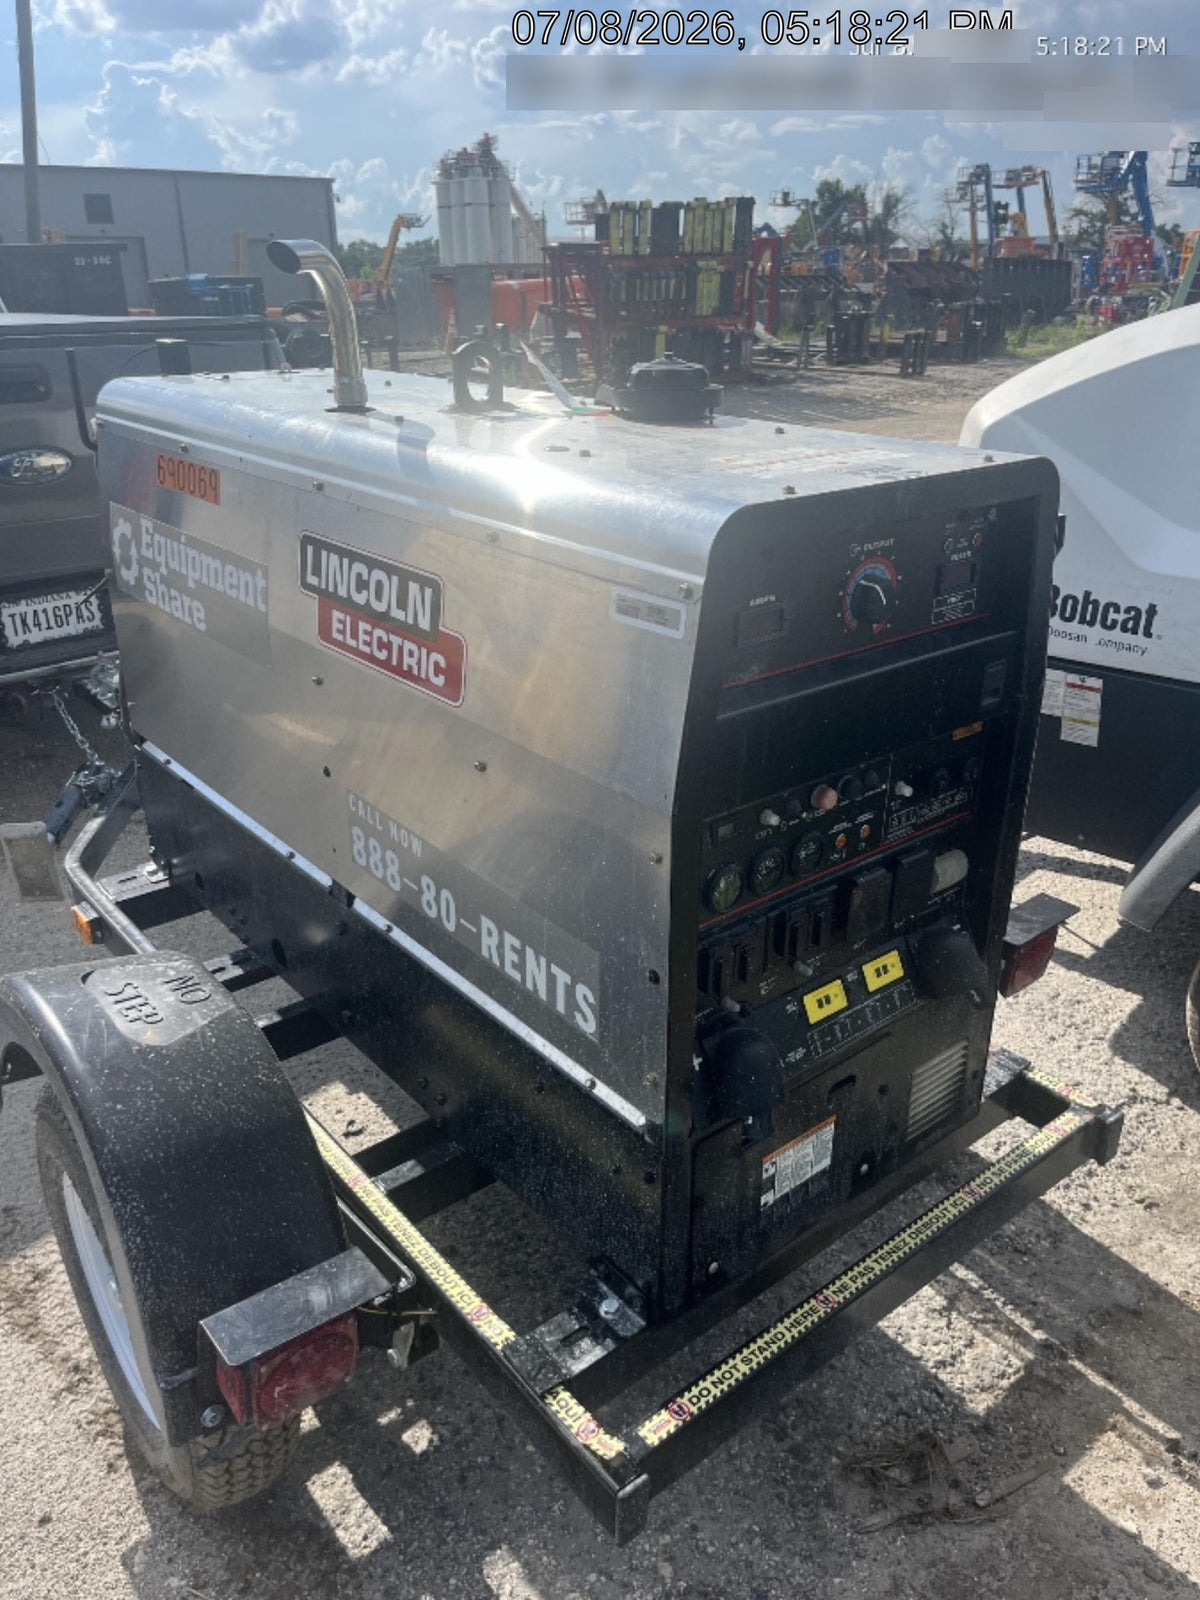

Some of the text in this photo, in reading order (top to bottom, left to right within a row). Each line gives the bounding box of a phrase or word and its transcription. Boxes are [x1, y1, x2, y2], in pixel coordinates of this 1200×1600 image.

[156, 454, 218, 500] 690069
[140, 518, 267, 612] Equipment
[305, 544, 433, 632] LINCOLN
[142, 567, 207, 632] Share
[331, 609, 447, 687] ELECTRIC
[1095, 637, 1148, 656] ompany
[349, 793, 423, 858] CALL NOW
[351, 826, 597, 1034] 888-80-RENTS
[104, 983, 164, 1025] STEP
[163, 975, 212, 1004] NO
[418, 1248, 459, 1290] DEBOUT
[457, 1291, 475, 1307] ICI
[687, 1386, 712, 1407] DO
[711, 1364, 742, 1390] NOT
[740, 1331, 787, 1366] STAND
[785, 1305, 820, 1333] HERE
[834, 1281, 852, 1295] NE
[849, 1265, 876, 1286] PAS
[875, 1240, 911, 1266] TENEZ
[909, 1209, 950, 1240] DEBOUT
